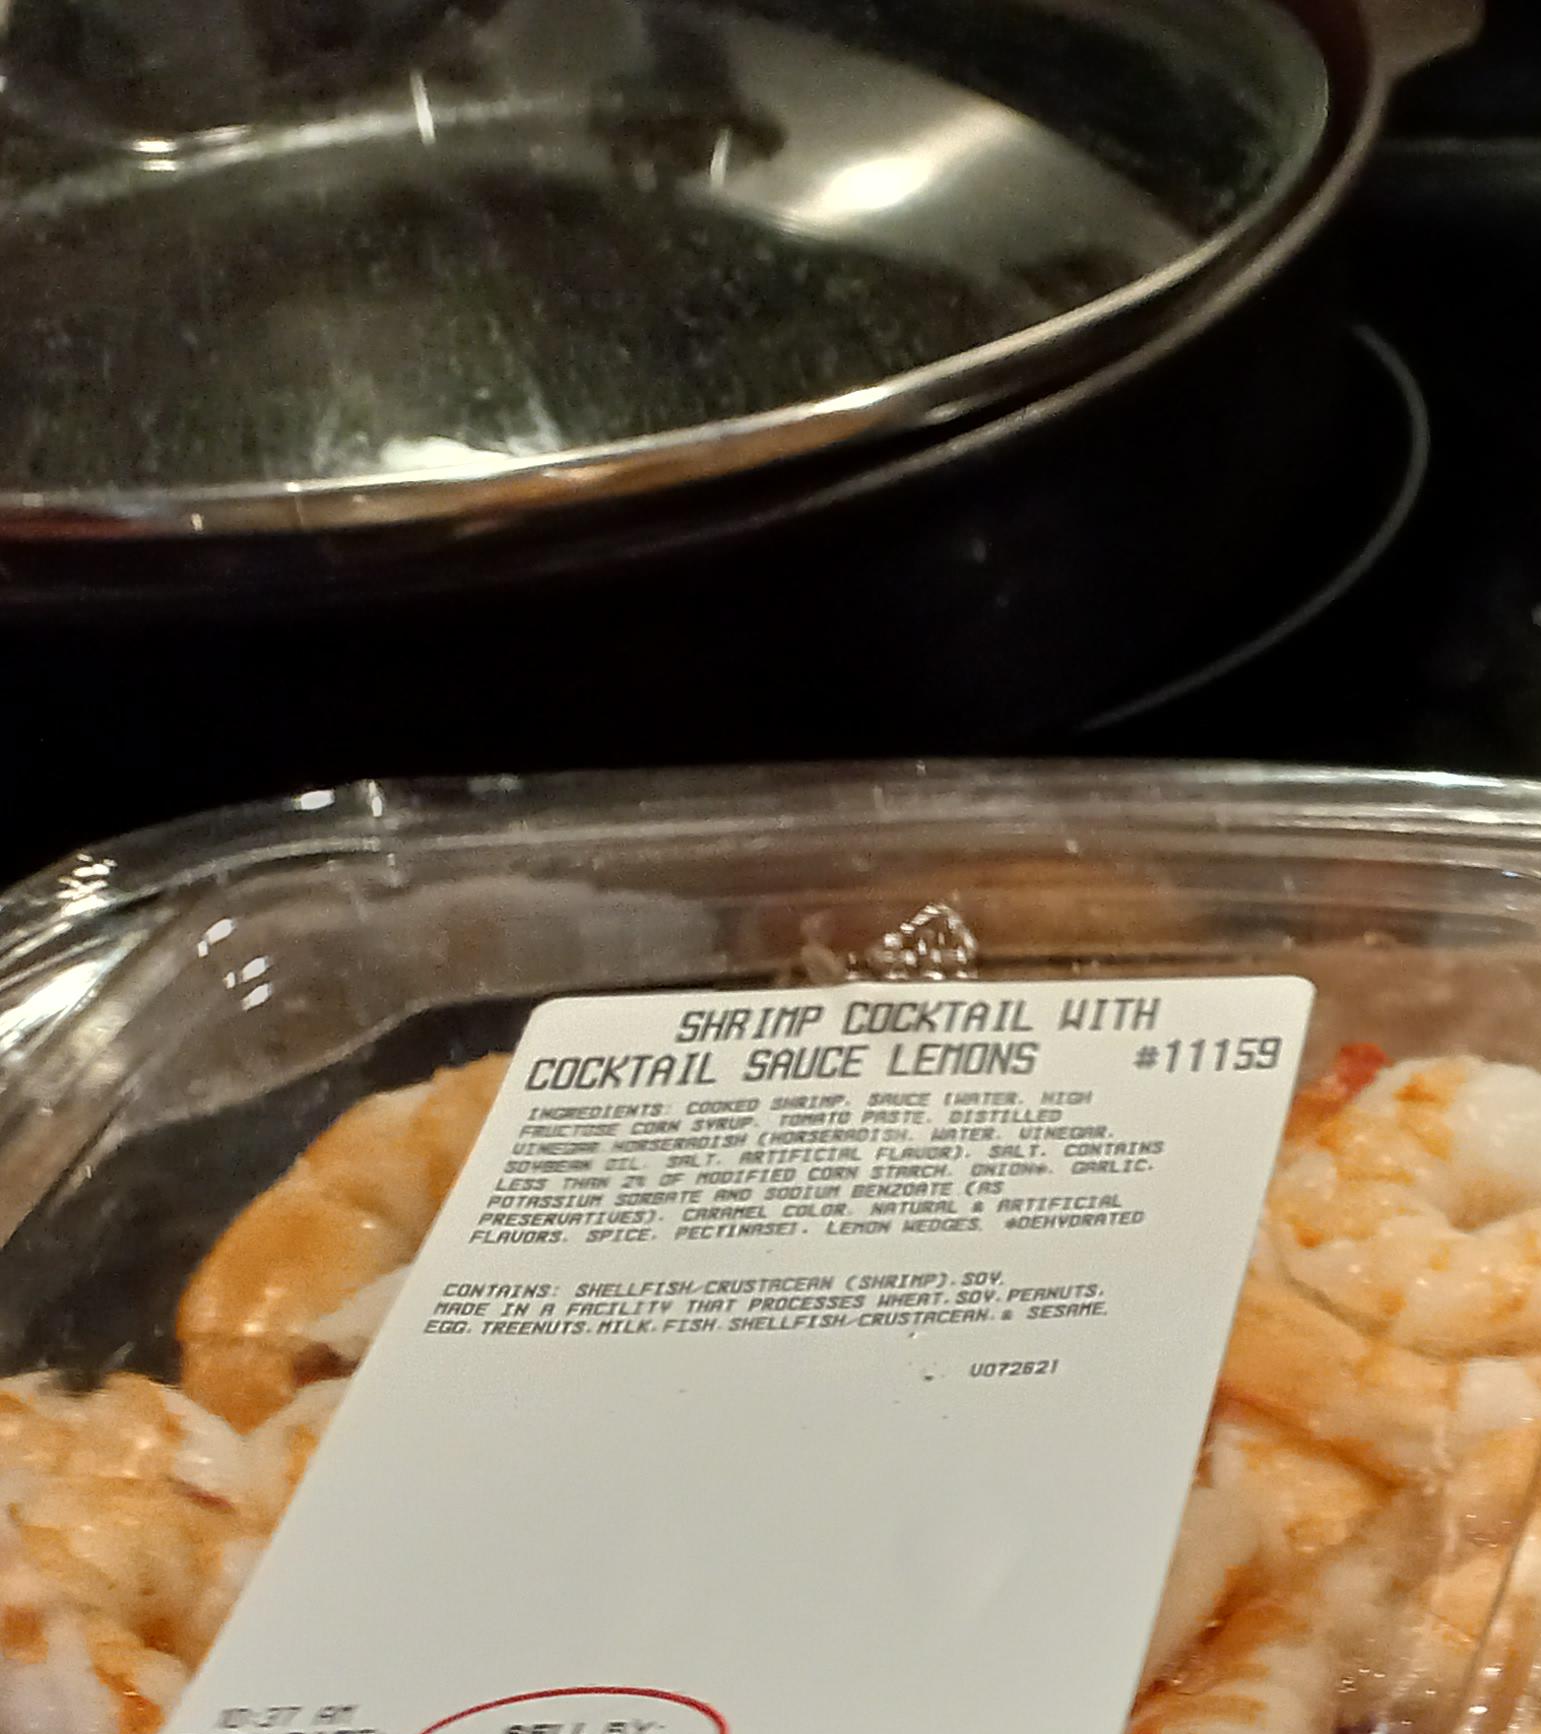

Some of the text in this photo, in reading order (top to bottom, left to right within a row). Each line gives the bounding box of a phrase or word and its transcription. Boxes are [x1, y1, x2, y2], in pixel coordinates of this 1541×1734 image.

[675, 997, 1161, 1043] SHRIMP COCKTAIL WITH
[525, 1037, 1283, 1091] COCKTAIL SAUCE LEMONS #11159
[686, 1100, 759, 1117] COOKED
[868, 1094, 931, 1111] SAUCE
[631, 1119, 679, 1135] CORN
[780, 1114, 849, 1131] TOMATO
[949, 1109, 1063, 1127] DISTILLED
[739, 1148, 861, 1167] ARTIFICIAL
[1064, 1139, 1164, 1158] CONTAINS
[497, 1175, 548, 1192] LESS
[563, 1173, 610, 1190] THAN
[659, 1171, 686, 1187] OF
[696, 1168, 797, 1186] MODIFIED
[807, 1166, 858, 1183] CORN
[487, 1179, 1004, 1209] POTASSIUM SORBATE AND SODIUM BENZOATE (AS
[682, 1203, 767, 1221] CARAMEL
[871, 1198, 958, 1216] NATURAL
[971, 1197, 983, 1213] &
[997, 1193, 1123, 1212] ARTIFICIAL
[825, 1216, 891, 1234] LEMON
[443, 1283, 559, 1299] CONTAINS:
[433, 1302, 491, 1317] MADE
[502, 1301, 530, 1317] IN
[540, 1301, 555, 1316] A
[566, 1298, 671, 1316] FACILITY
[688, 1297, 737, 1313] THAT
[749, 1293, 864, 1311] PROCESSES
